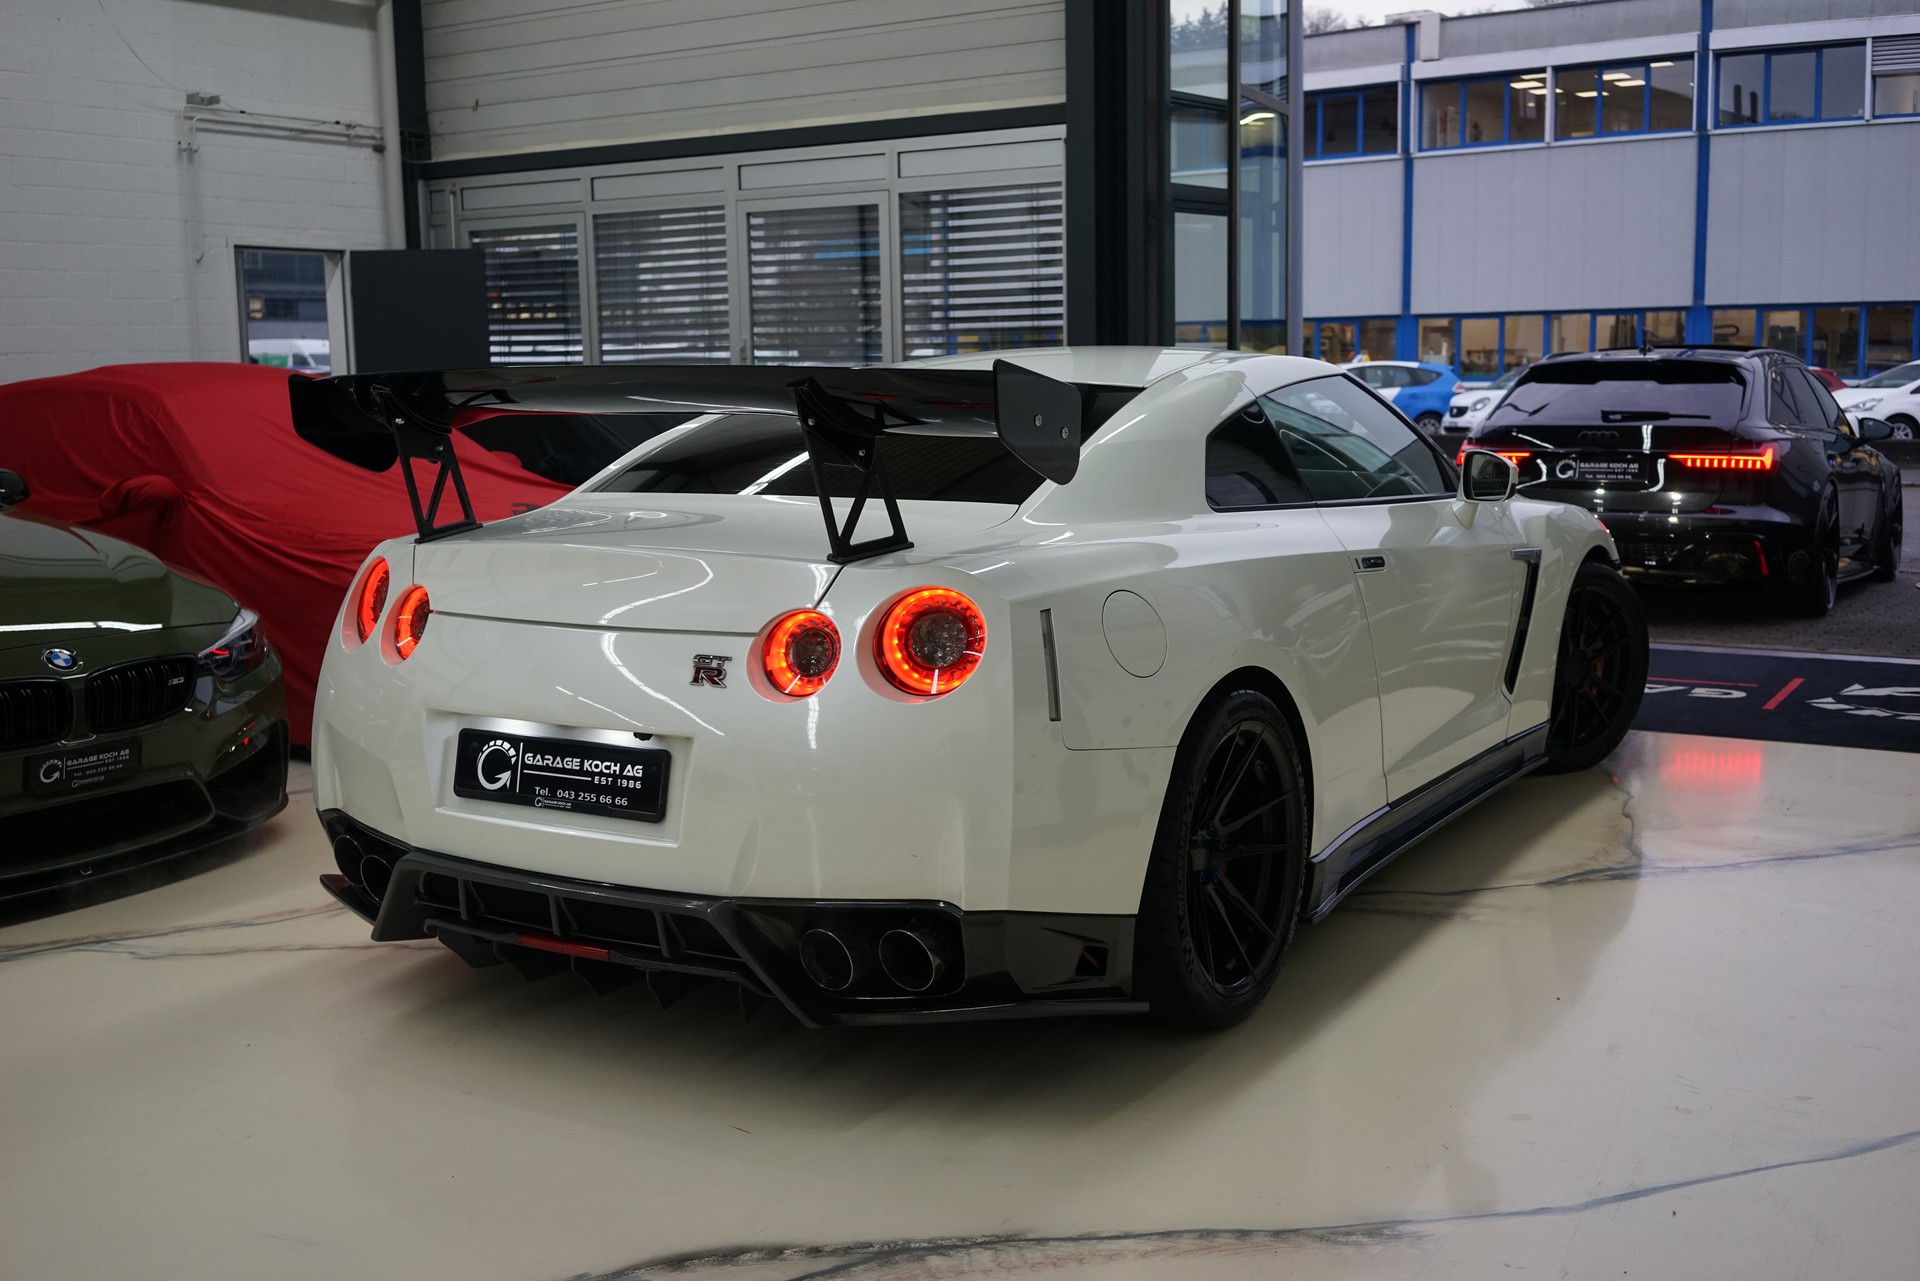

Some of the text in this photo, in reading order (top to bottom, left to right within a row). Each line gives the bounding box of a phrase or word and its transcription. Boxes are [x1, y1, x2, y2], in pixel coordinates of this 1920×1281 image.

[67, 748, 130, 766] GARAGE KOCH AG
[524, 752, 643, 777] GARAGE KOCH AG
[594, 776, 642, 789] EST 1986
[534, 786, 628, 806] Tel. 043 255 66 66
[1177, 823, 1188, 916] MICHELIN
